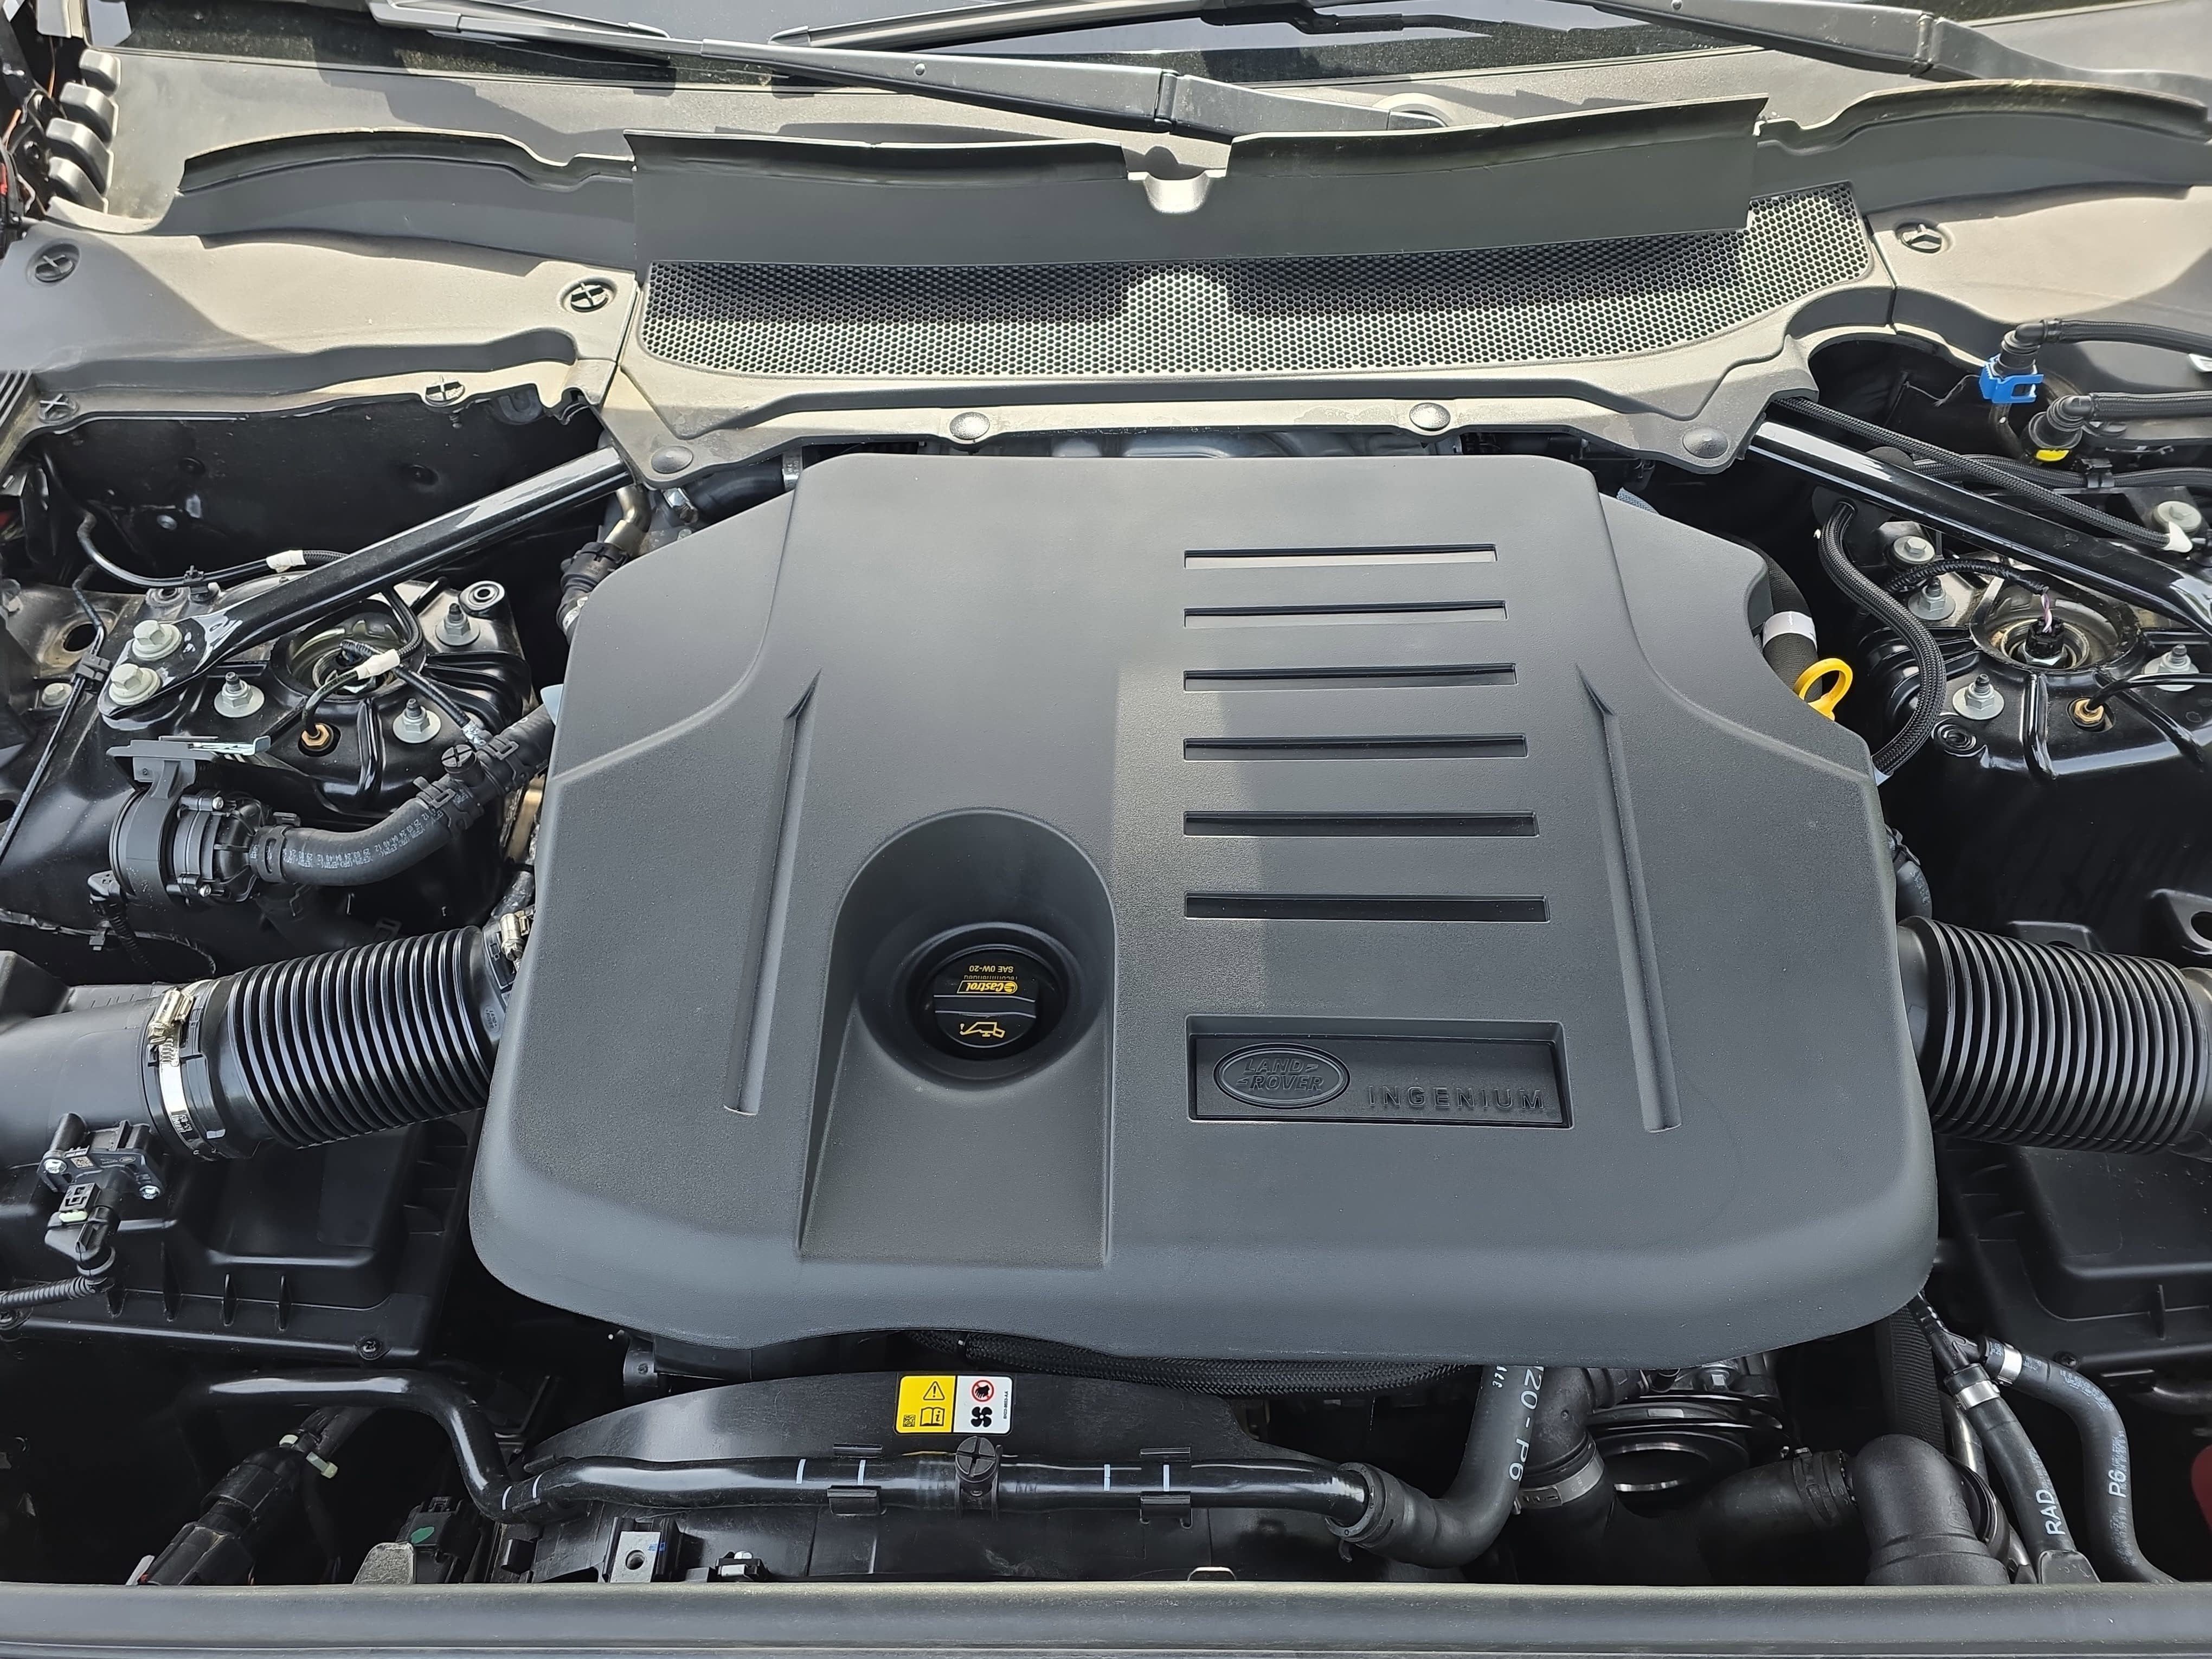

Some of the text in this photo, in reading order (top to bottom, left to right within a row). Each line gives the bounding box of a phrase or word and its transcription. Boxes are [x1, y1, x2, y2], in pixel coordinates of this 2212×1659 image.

[968, 964, 1014, 974] SAE 0W-20
[965, 982, 1004, 992] Castrol
[1244, 1058, 1306, 1074] LAND
[1249, 1074, 1324, 1092] ROVER
[1367, 1085, 1545, 1110] INGENIUM
[1520, 1366, 1544, 1410] 20
[1509, 1438, 1529, 1482] P6
[2108, 1469, 2128, 1499] P6
[2035, 1488, 2067, 1536] RAD
